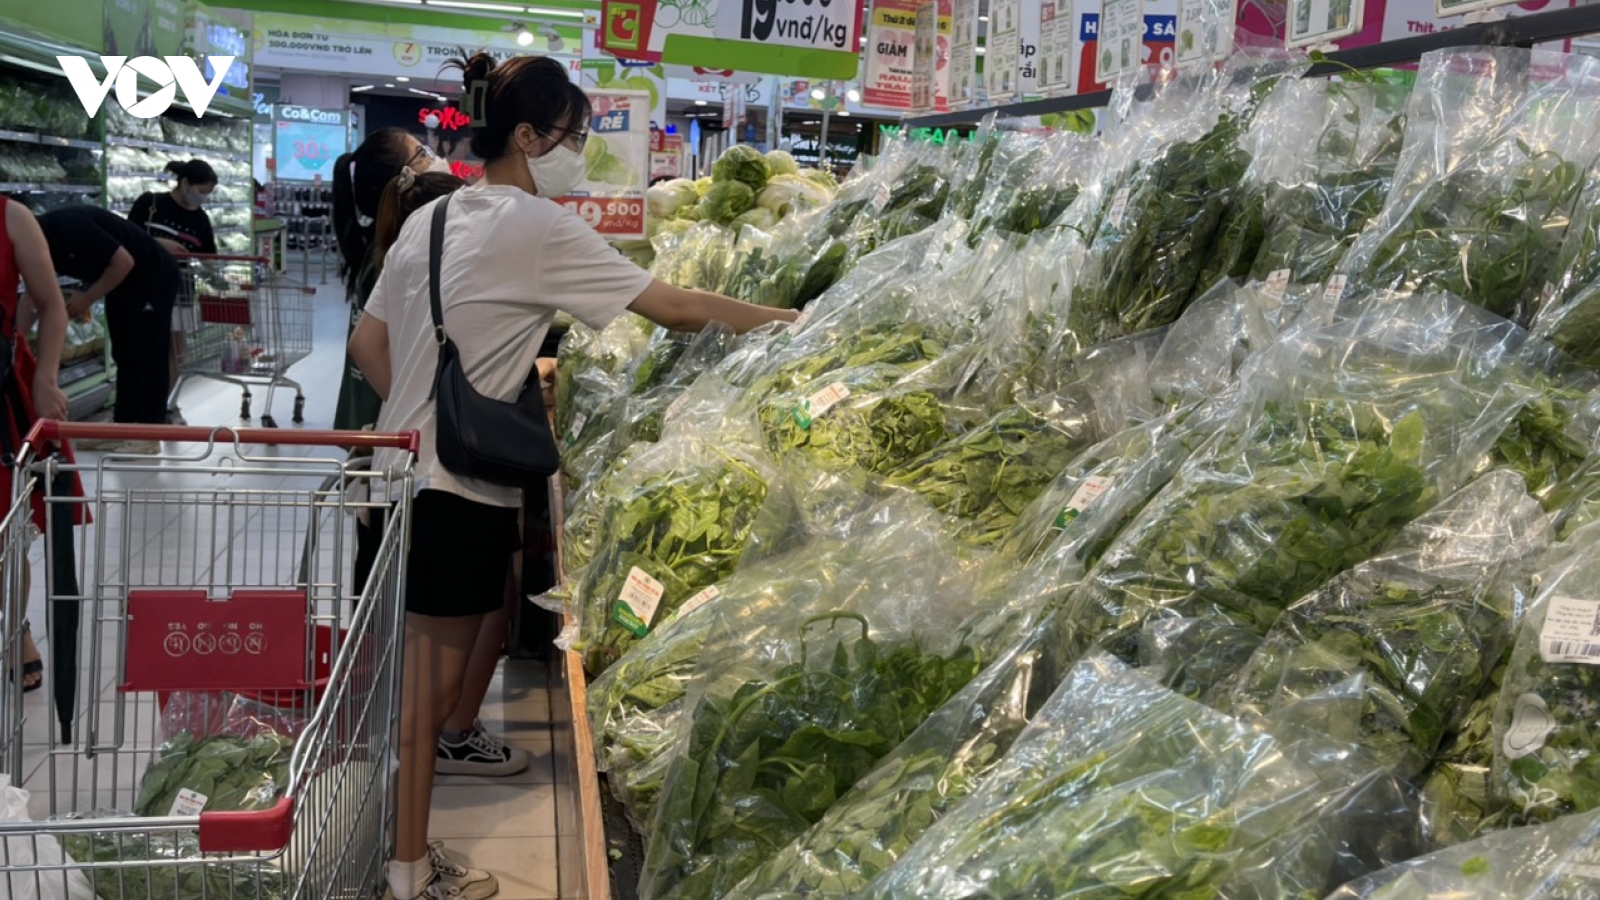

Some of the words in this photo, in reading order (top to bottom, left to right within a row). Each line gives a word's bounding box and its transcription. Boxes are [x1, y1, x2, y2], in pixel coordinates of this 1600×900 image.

[611, 8, 626, 18] Big
[776, 14, 847, 48] vnđ/kg
[877, 40, 908, 57] GIẢM
[281, 106, 342, 122] Co&Com
